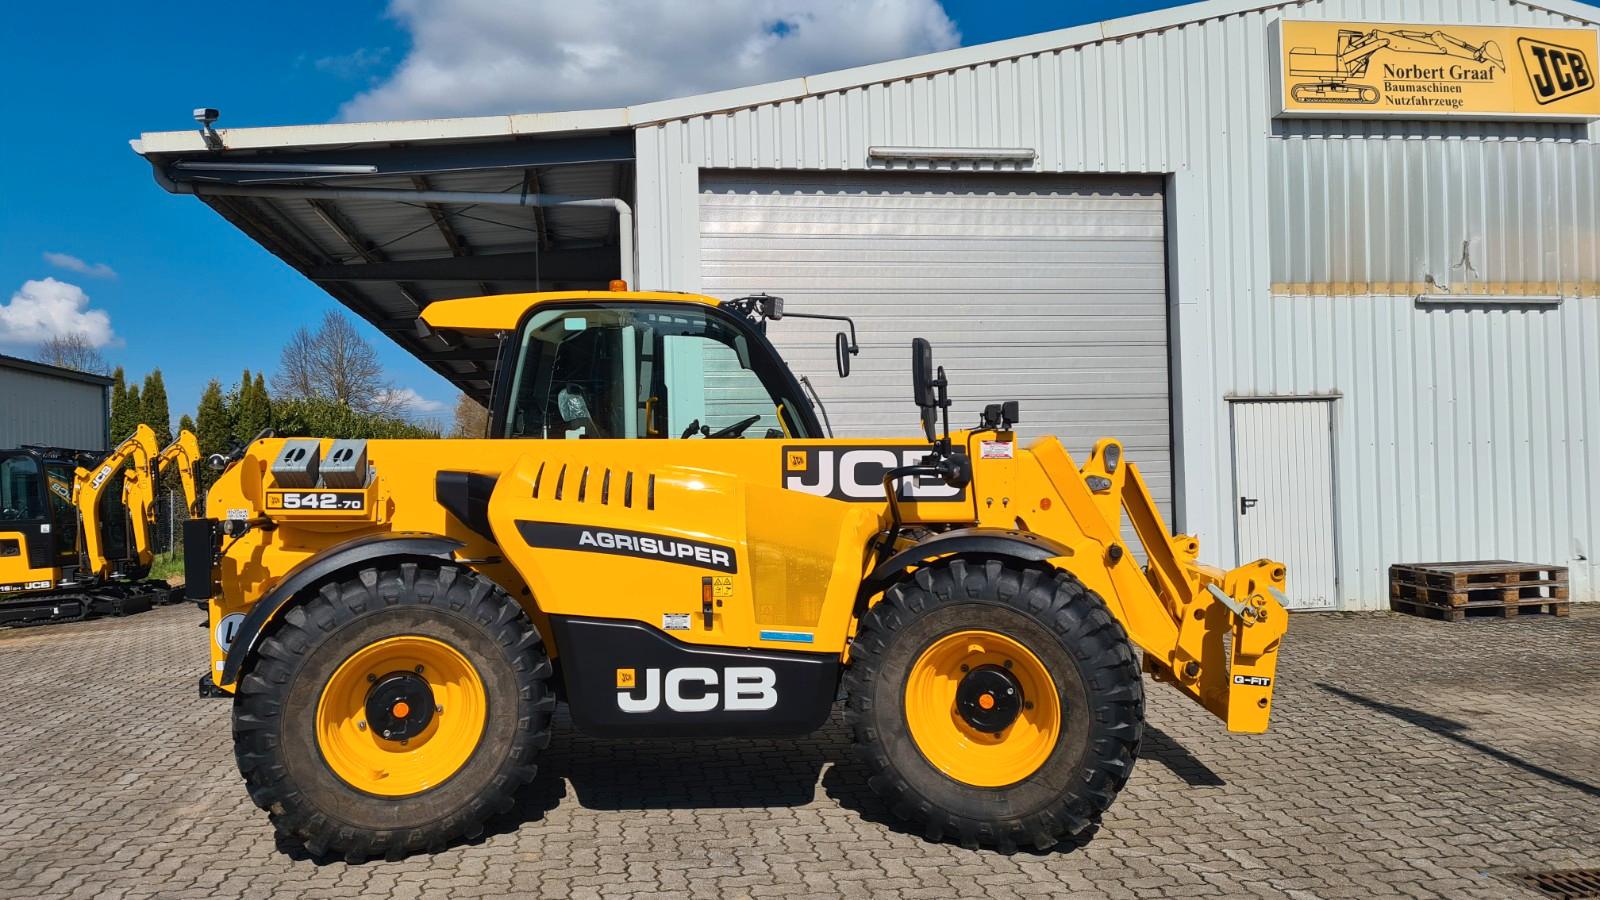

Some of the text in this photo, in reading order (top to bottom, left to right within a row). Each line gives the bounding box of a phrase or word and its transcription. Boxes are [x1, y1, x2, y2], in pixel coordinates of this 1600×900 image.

[1383, 62, 1496, 81] Norbert Graaf
[1532, 45, 1587, 97] JCB
[1384, 82, 1462, 93] Baumaschinen
[1385, 95, 1464, 109] Nutzfahrzeuge
[92, 465, 112, 490] JCB
[283, 493, 361, 509] 542-70
[578, 530, 731, 567] AGRISUPER
[24, 581, 50, 590] JCB
[617, 667, 778, 713] JCB
